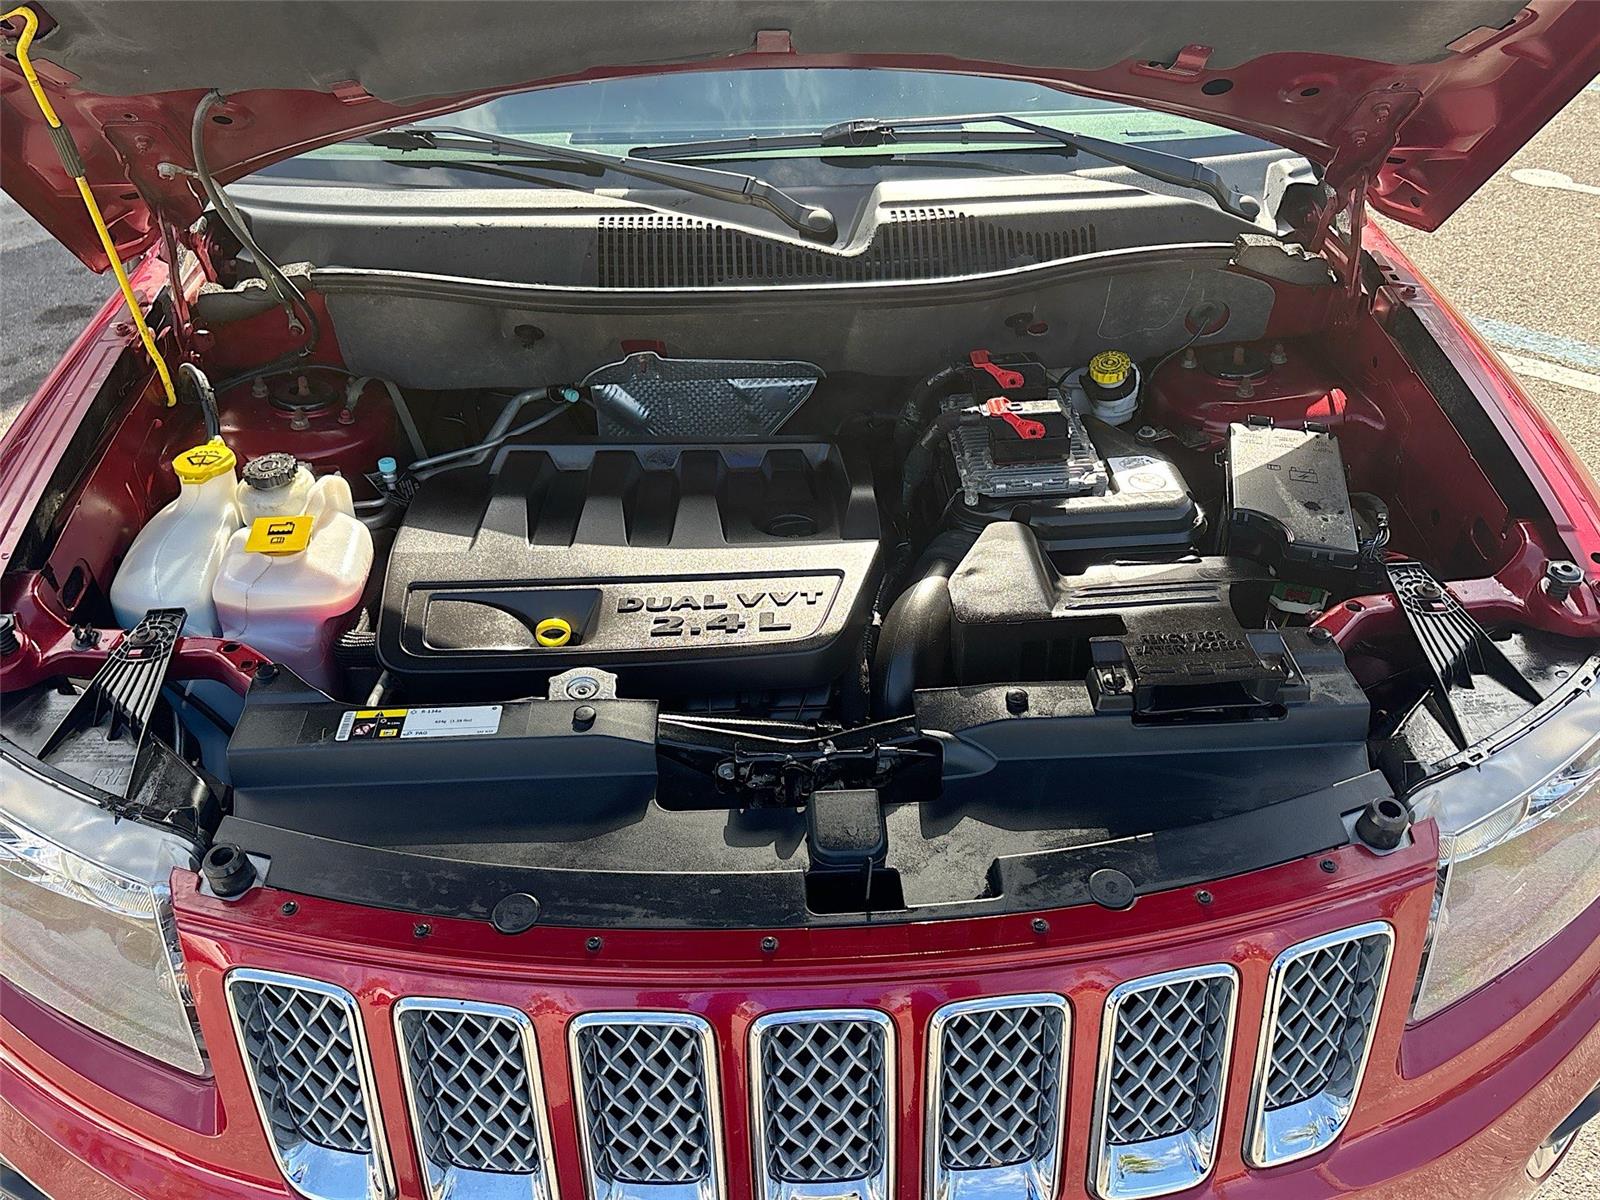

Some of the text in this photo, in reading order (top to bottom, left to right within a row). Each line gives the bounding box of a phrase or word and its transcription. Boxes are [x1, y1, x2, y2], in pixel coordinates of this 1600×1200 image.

[617, 590, 824, 613] DUAL VVT
[1196, 630, 1226, 642] FOR
[1191, 639, 1246, 653] ACCESS
